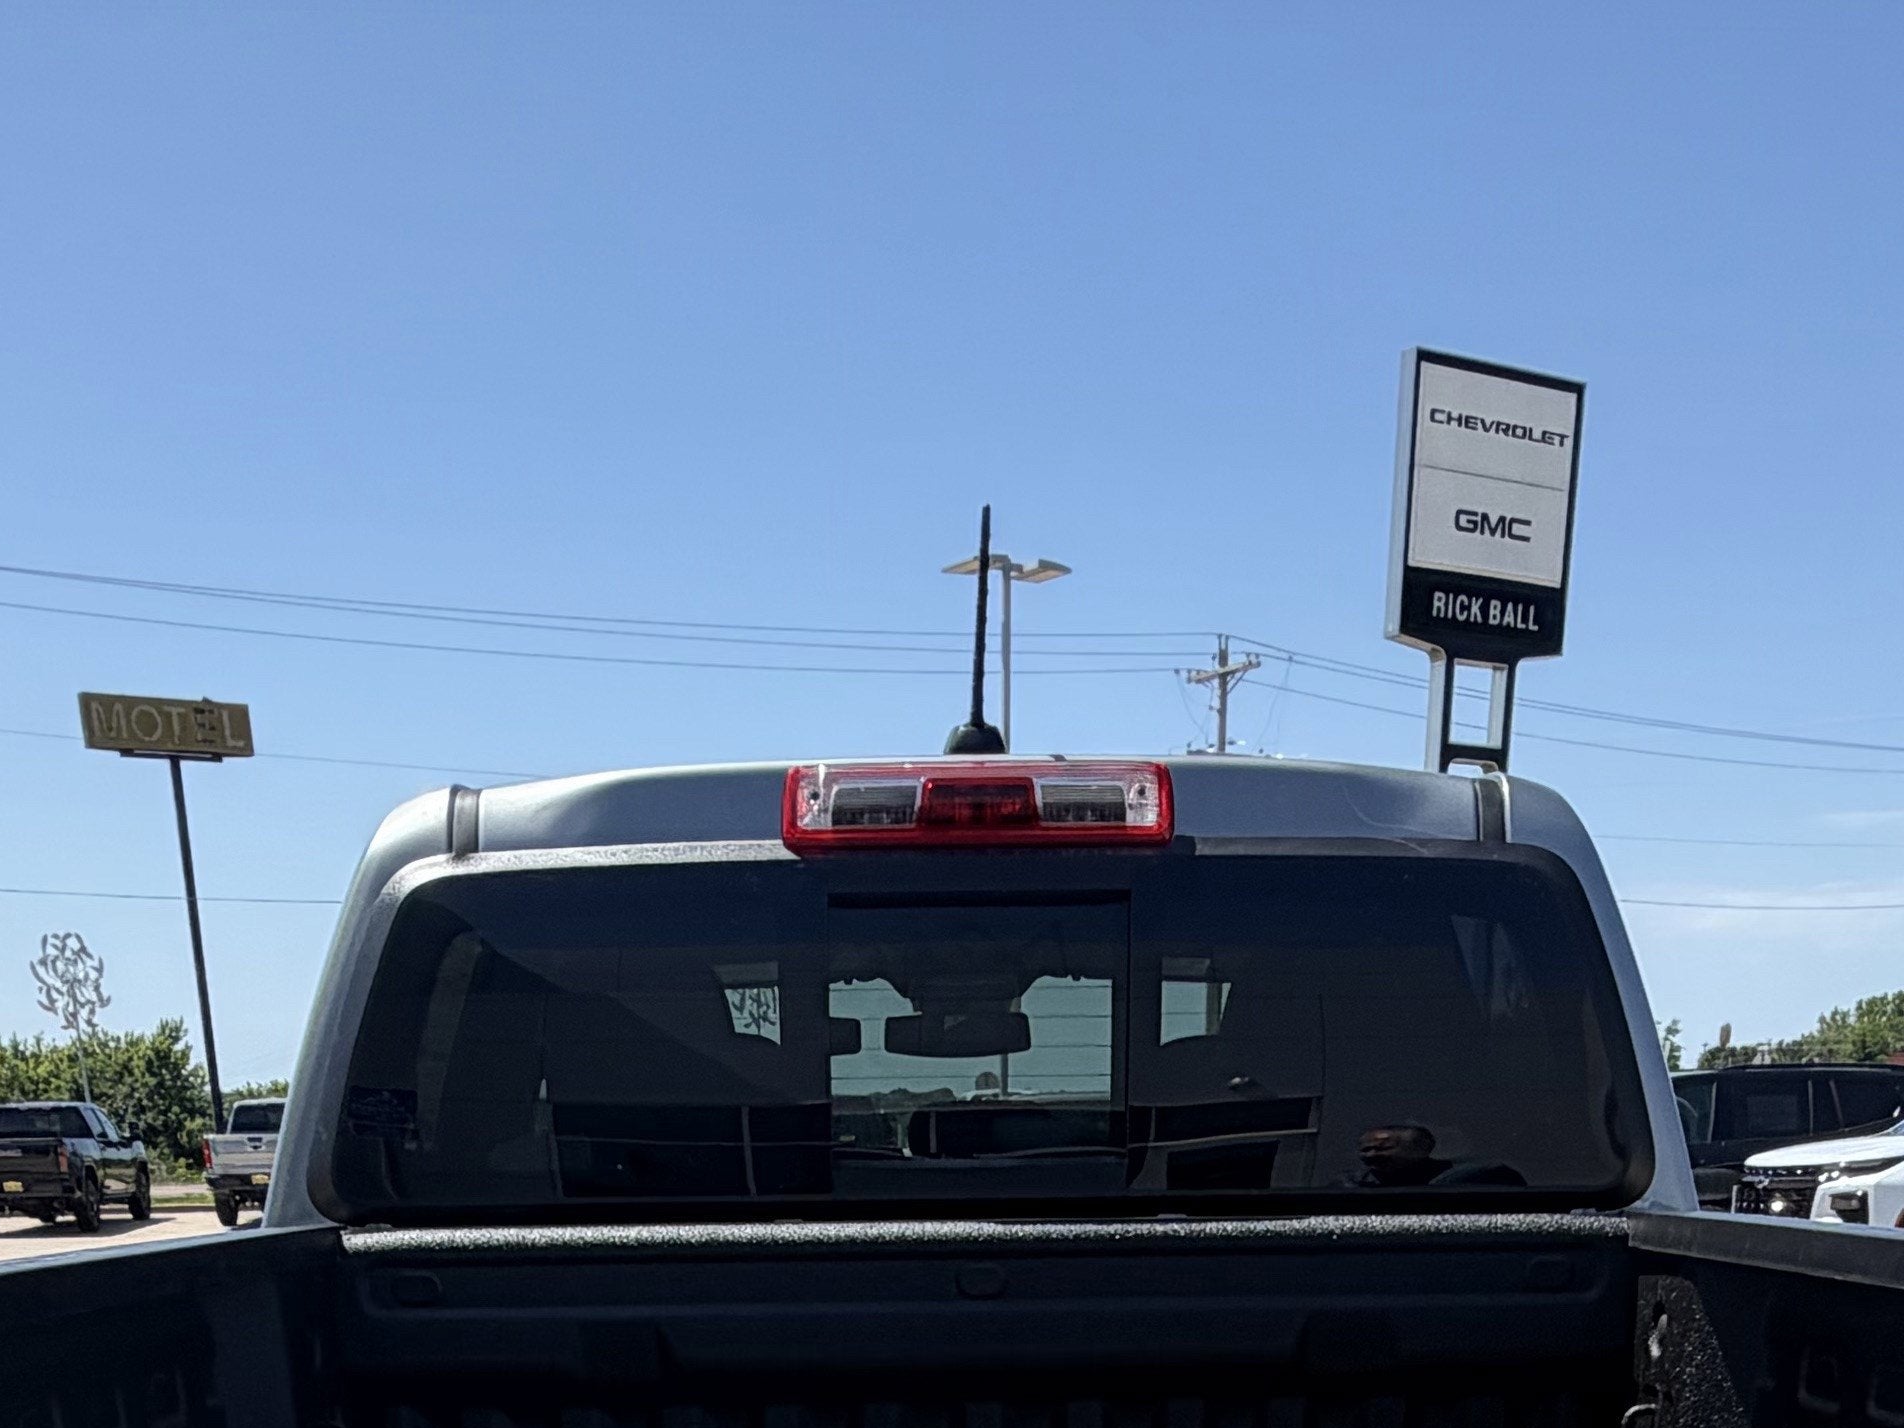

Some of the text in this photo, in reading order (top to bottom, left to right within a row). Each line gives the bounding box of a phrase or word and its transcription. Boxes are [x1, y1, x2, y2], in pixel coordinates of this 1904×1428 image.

[1429, 407, 1570, 448] CHEVROLET
[1454, 508, 1532, 543] GMC
[1432, 591, 1539, 632] RICK BALL
[91, 700, 245, 748] MOTEL
